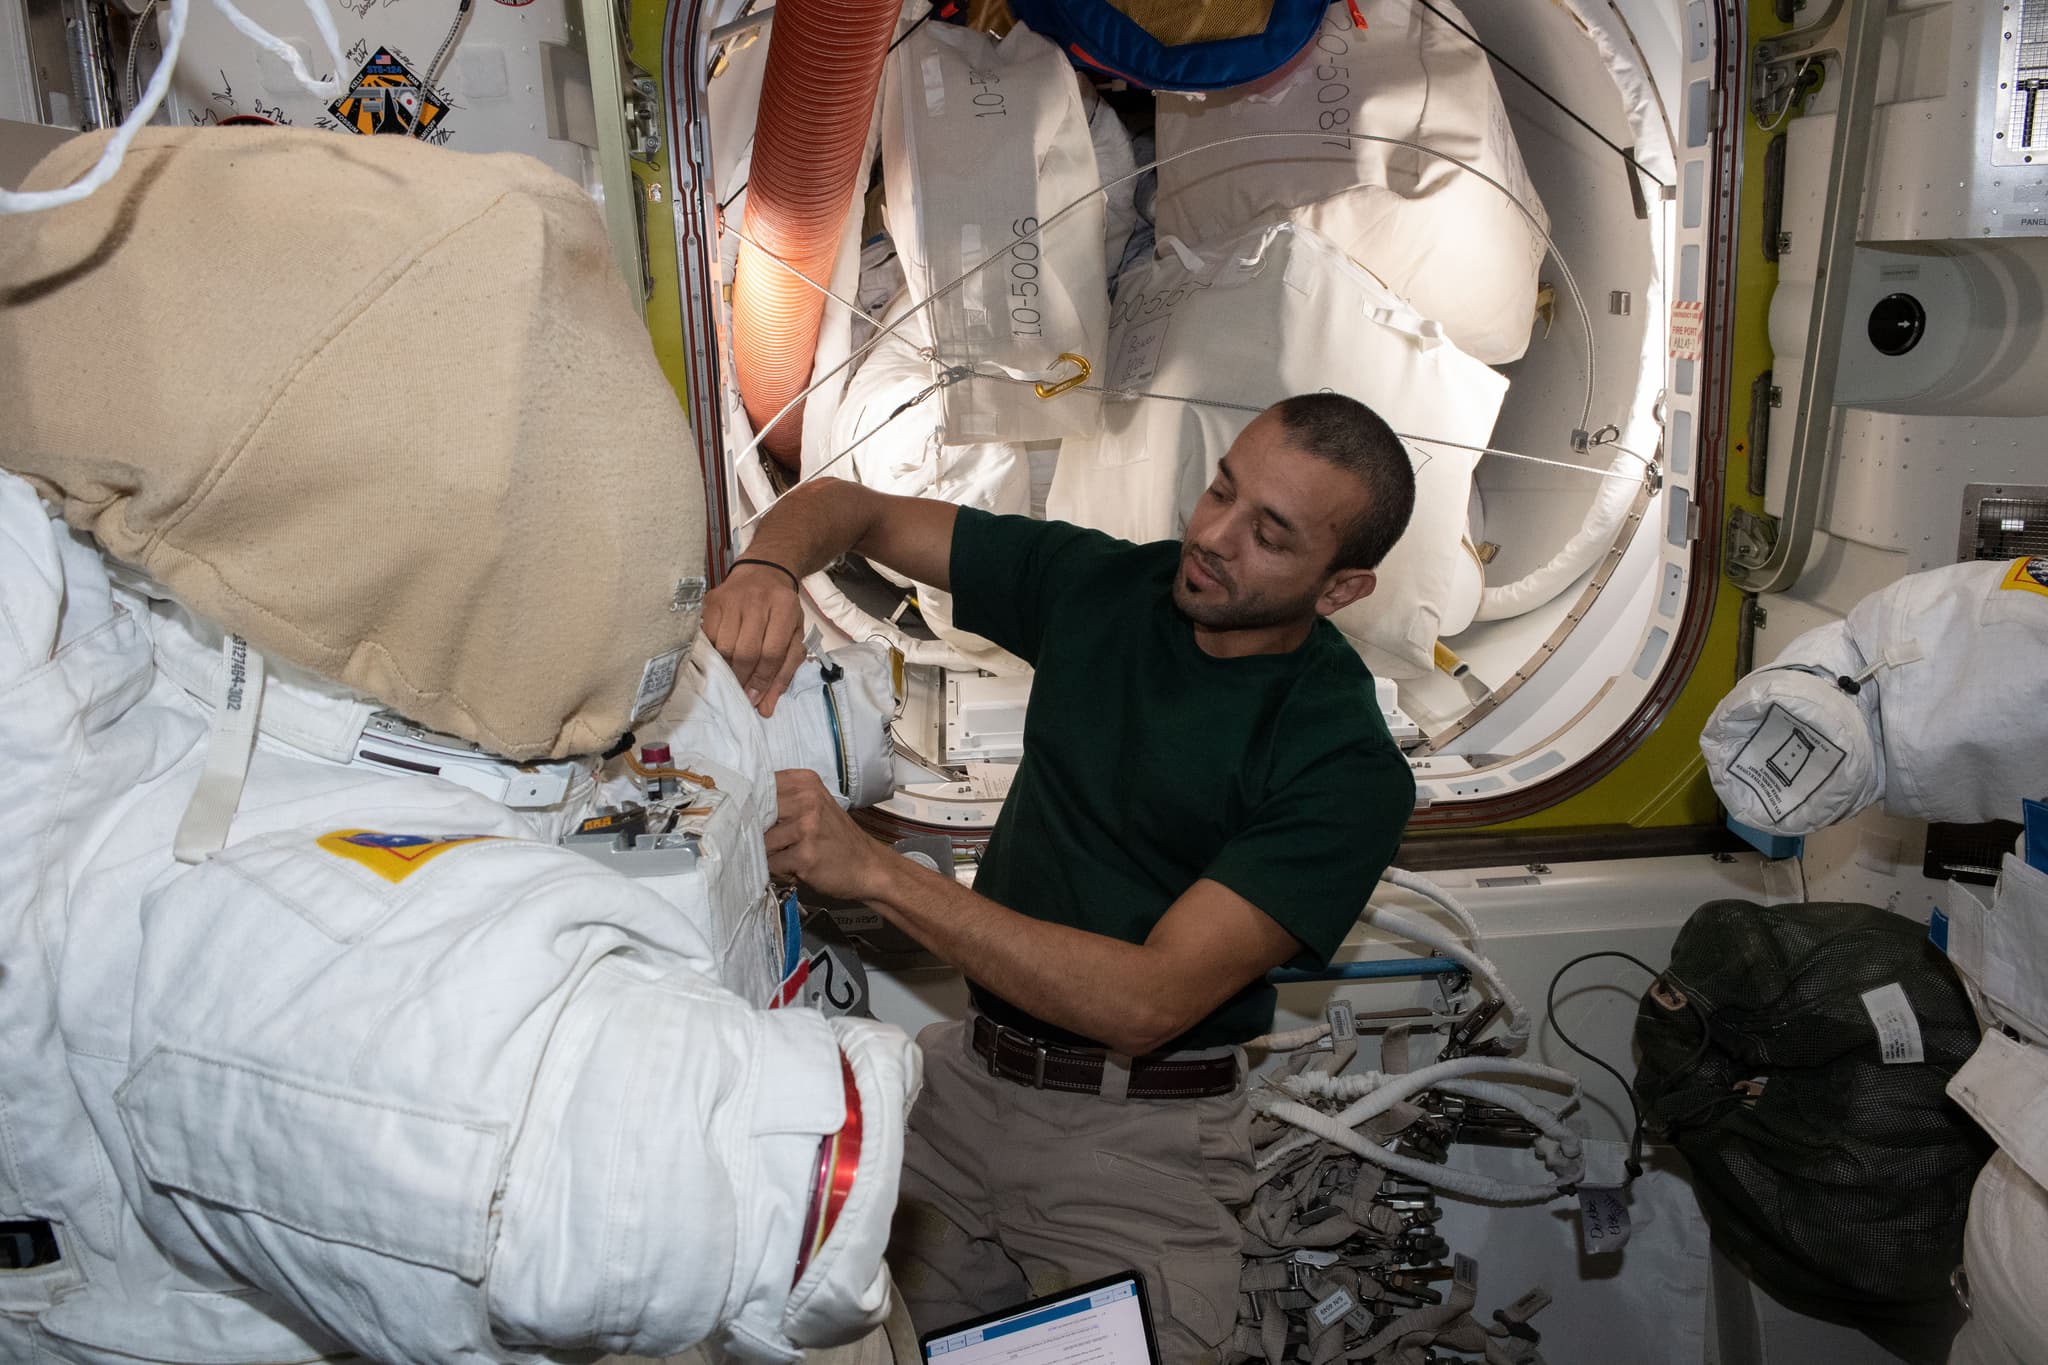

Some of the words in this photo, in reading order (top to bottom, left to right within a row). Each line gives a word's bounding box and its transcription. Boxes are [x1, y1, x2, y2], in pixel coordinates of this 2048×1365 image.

[366, 65, 402, 74] STS-124
[350, 74, 365, 90] KELLY
[407, 73, 420, 86] HAM
[335, 112, 359, 133] FOSSUM
[2020, 218, 2048, 226] PANEL
[1011, 216, 1042, 338] 1.0-5006
[1672, 325, 1684, 335] FIRE
[1684, 326, 1697, 336] PORT
[808, 950, 854, 1009] 2
